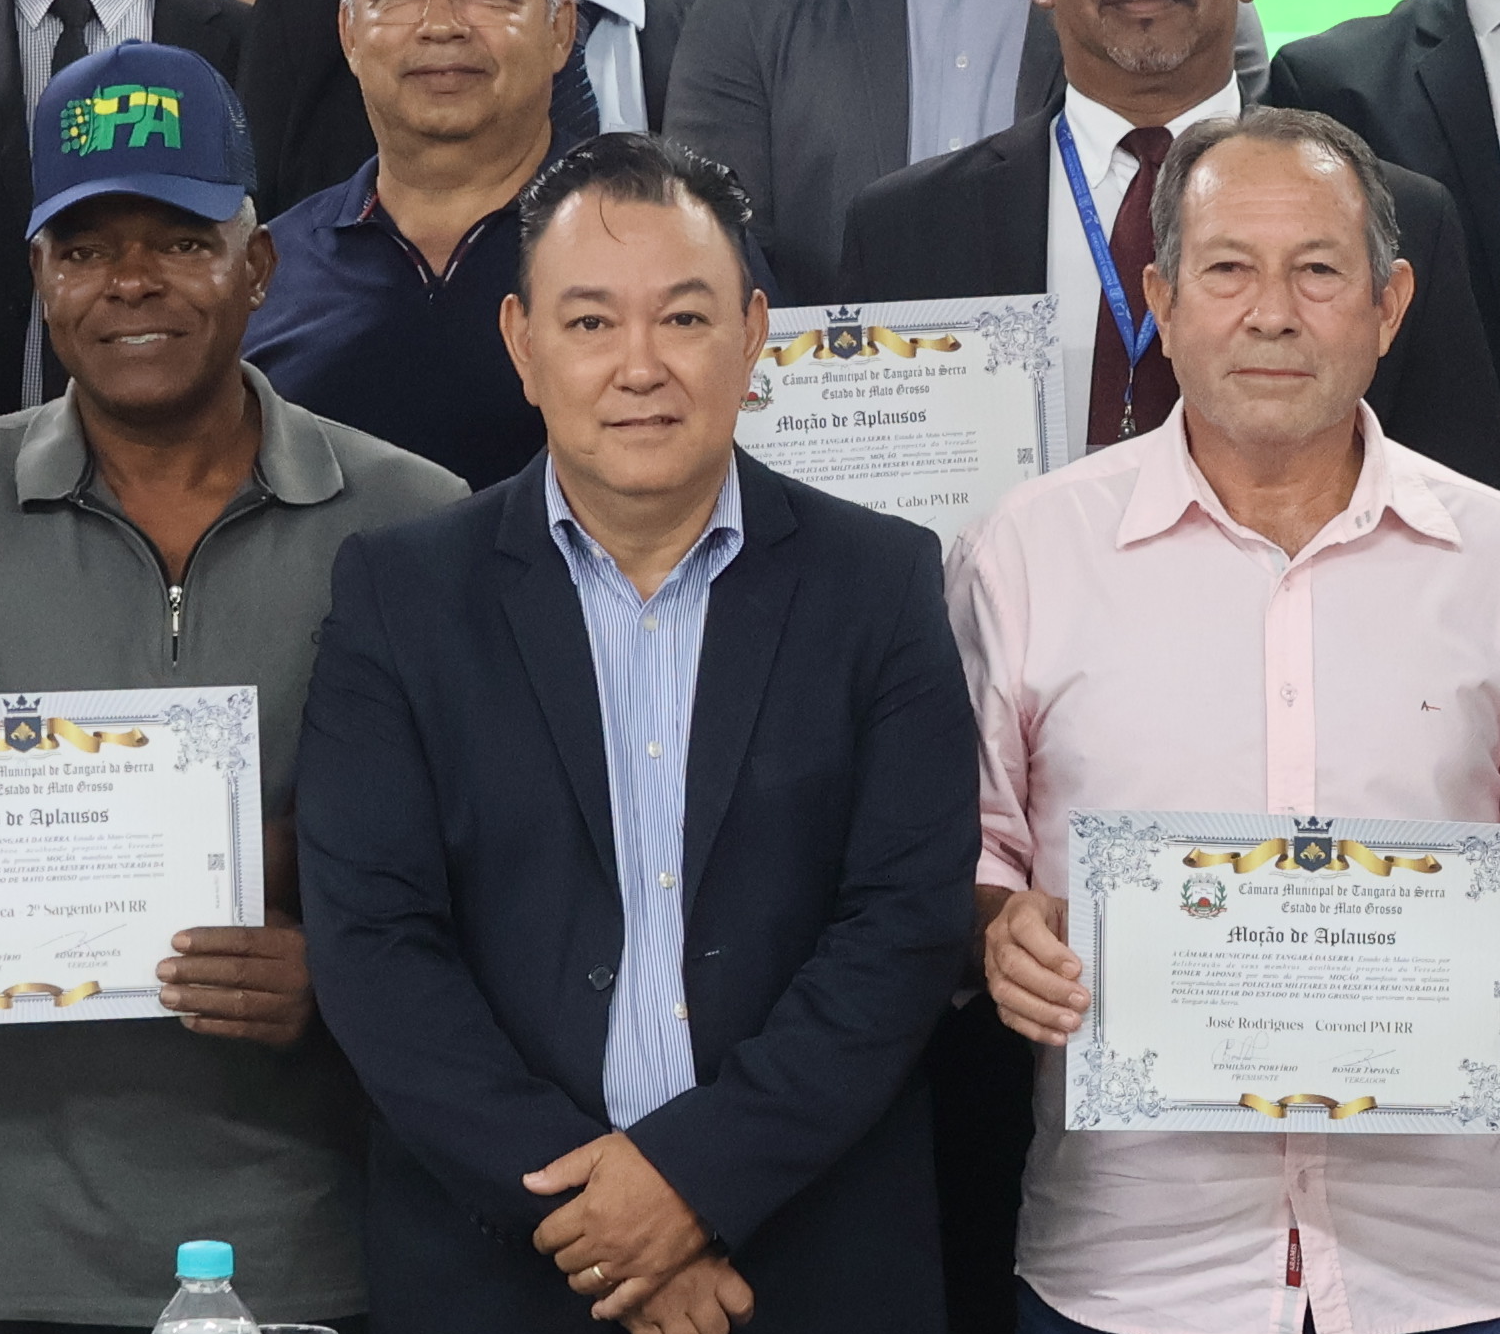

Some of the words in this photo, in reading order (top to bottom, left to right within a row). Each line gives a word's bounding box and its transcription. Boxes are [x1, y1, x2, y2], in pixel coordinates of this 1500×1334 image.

[775, 413, 827, 435] Moção
[831, 413, 849, 428] de
[852, 409, 927, 429] Aplausos
[896, 495, 928, 508] Cabo
[930, 492, 950, 507] PM
[951, 492, 969, 505] RR
[5, 810, 24, 827] de
[29, 808, 109, 828] Aplausos
[1238, 881, 1279, 896] Câmara
[1281, 883, 1334, 899] Municipal
[1337, 885, 1349, 897] de
[1351, 883, 1396, 900] Tangará
[1398, 885, 1411, 898] da
[1413, 885, 1446, 899] Serra
[43, 903, 102, 918] Sargento
[104, 900, 125, 914] PM
[128, 899, 147, 913] RR
[1280, 900, 1317, 914] Estado
[1319, 901, 1331, 914] de
[1333, 901, 1362, 915] Mato
[1364, 902, 1403, 915] Grosso
[1226, 925, 1285, 947] Moção
[1290, 927, 1309, 944] de
[1314, 927, 1397, 947] Aplausos
[1205, 1015, 1235, 1029] José
[1238, 1016, 1304, 1033] Rodrigues
[1315, 1020, 1367, 1033] Coronel
[1370, 1020, 1391, 1034] PM
[1394, 1021, 1413, 1034] RR
